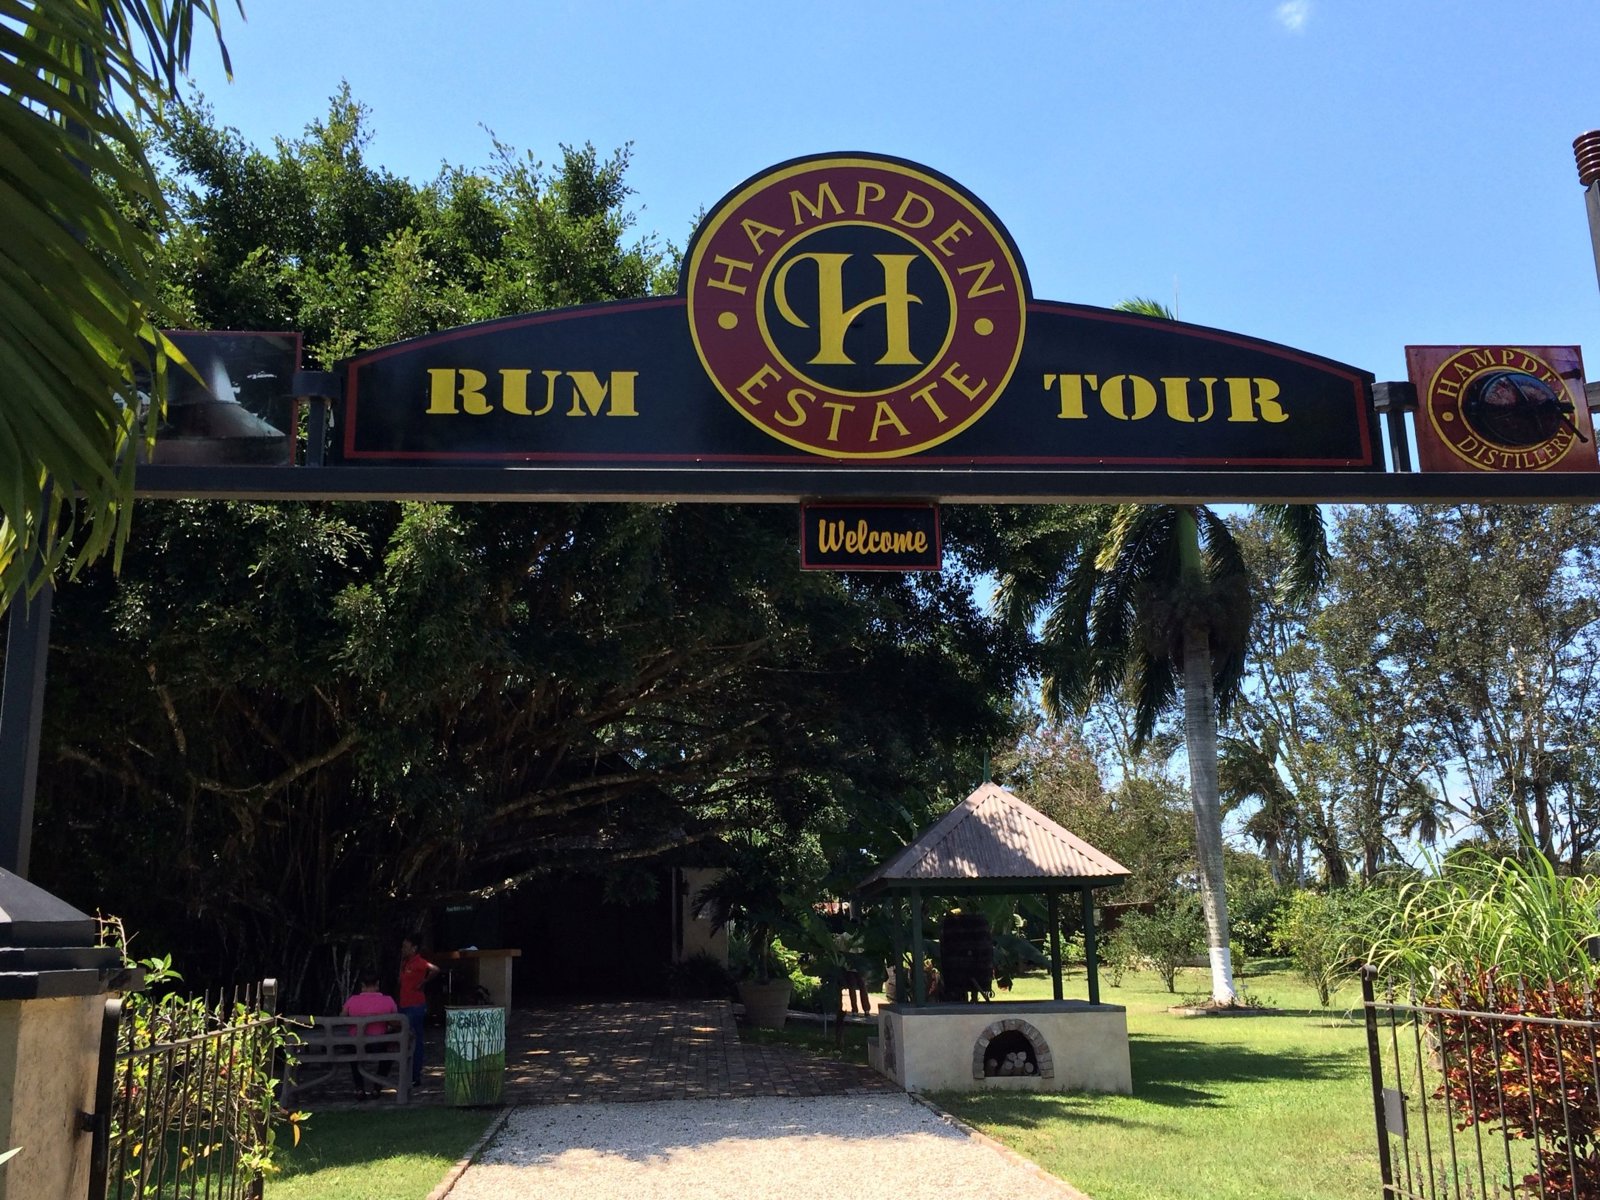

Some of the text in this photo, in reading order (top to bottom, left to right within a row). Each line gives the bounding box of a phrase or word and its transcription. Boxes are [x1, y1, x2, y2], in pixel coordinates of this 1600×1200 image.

[707, 181, 1006, 300] HAMPDEN
[774, 252, 923, 365] H
[426, 368, 1290, 423] RUM TOUR
[736, 362, 988, 442] ESTATE
[1456, 427, 1572, 469] DISTILLERY
[818, 519, 929, 555] Welcome
